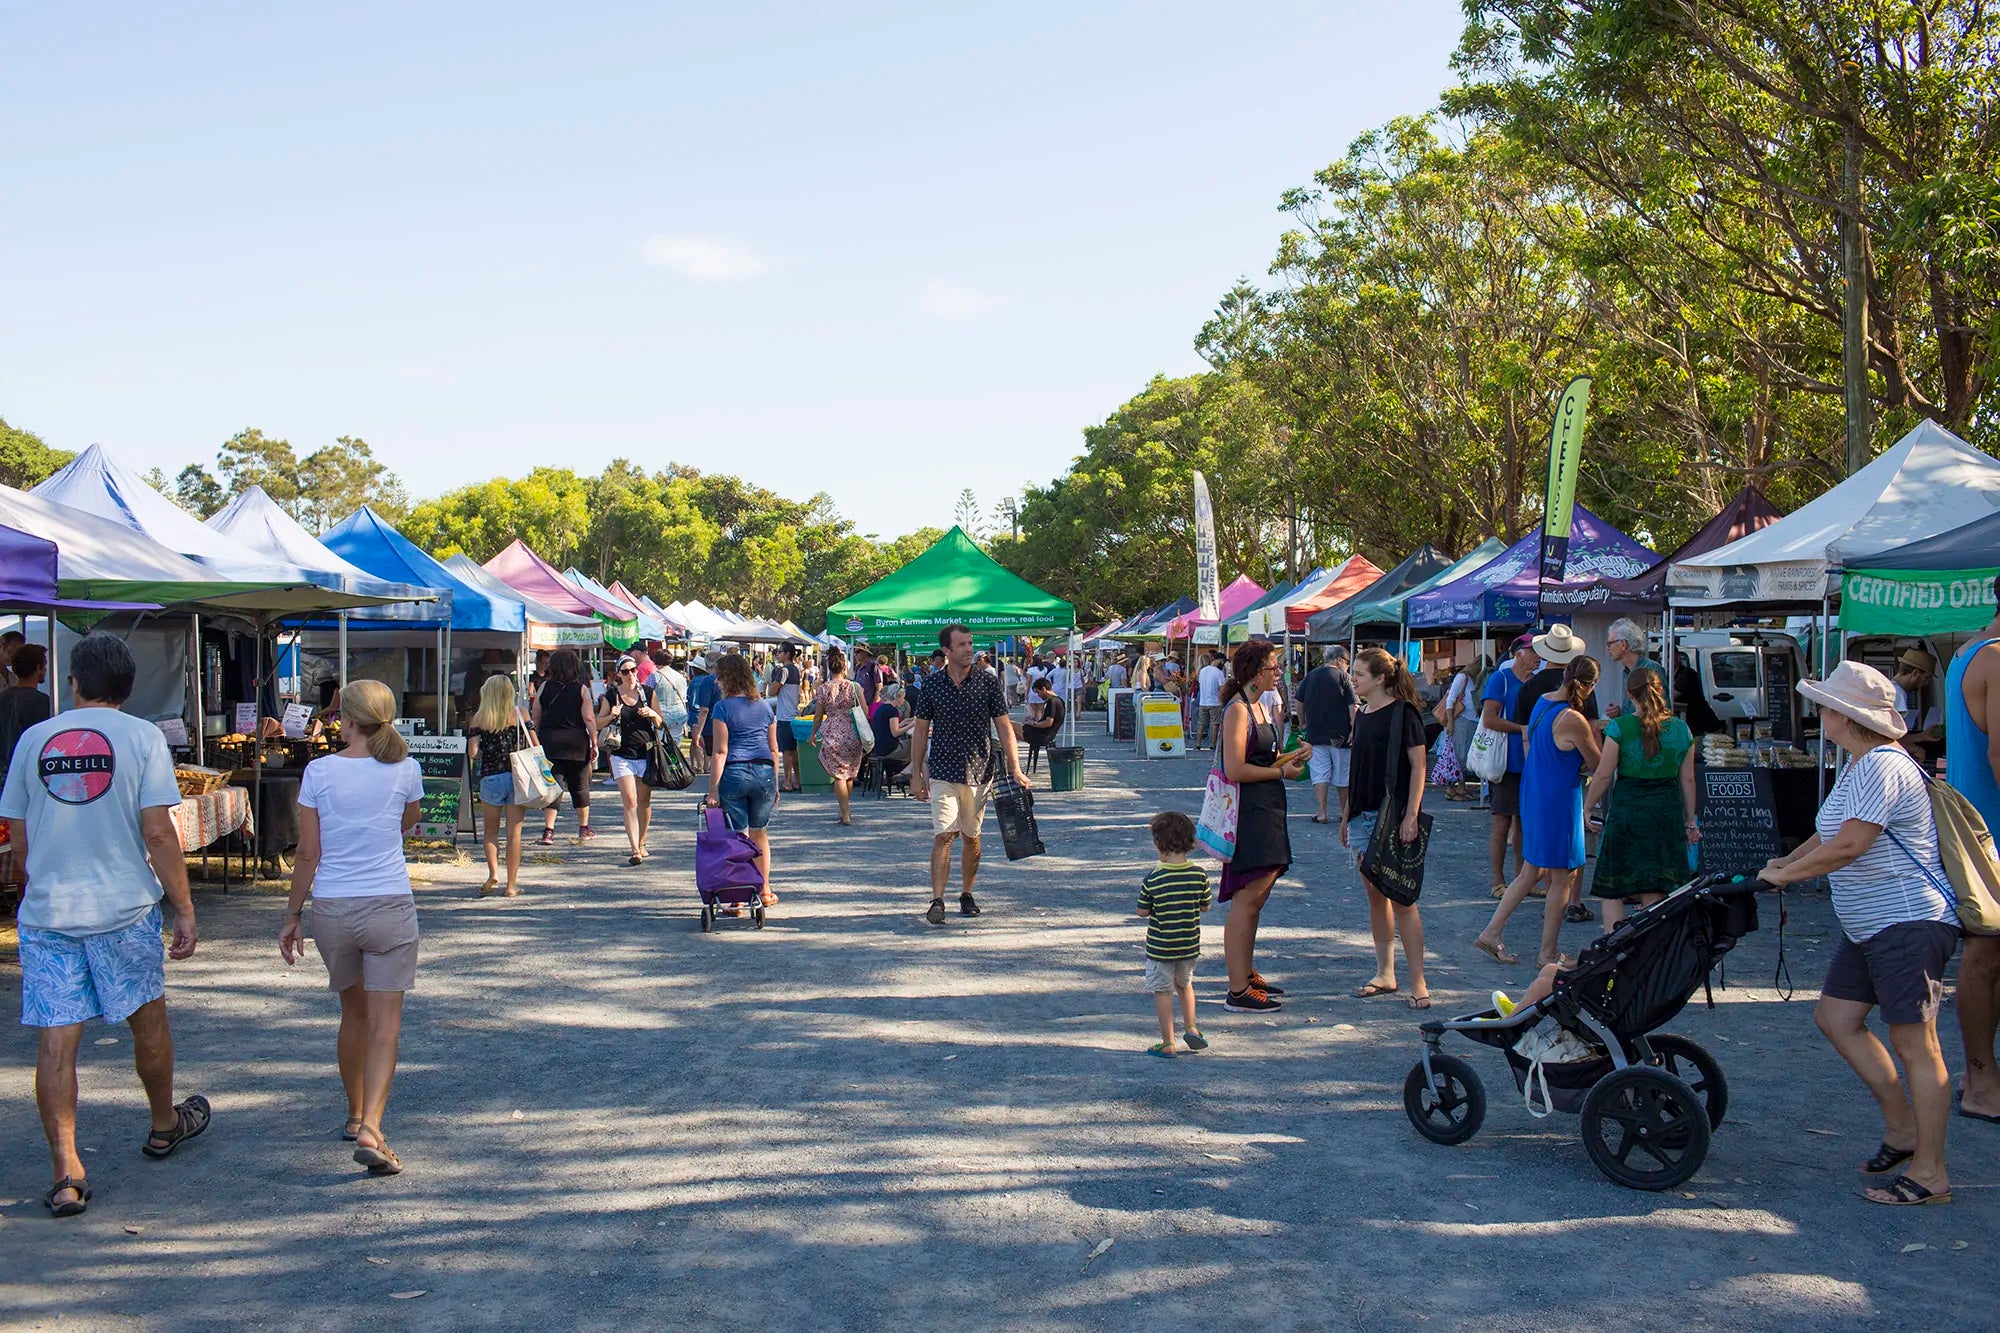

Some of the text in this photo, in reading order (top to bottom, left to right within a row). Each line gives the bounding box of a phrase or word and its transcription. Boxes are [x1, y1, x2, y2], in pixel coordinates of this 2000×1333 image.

[1848, 575, 1945, 609] CERTIFIED
[875, 619, 898, 627] Byron
[900, 618, 933, 626] Farmers
[934, 616, 962, 625] Market
[969, 616, 984, 624] real
[985, 615, 1018, 624] farmers,
[1019, 615, 1035, 623] real
[1036, 615, 1055, 623] food
[45, 758, 108, 771] O'NEILL
[1709, 774, 1750, 782] RAINFOREST
[1711, 783, 1752, 796] FOODS
